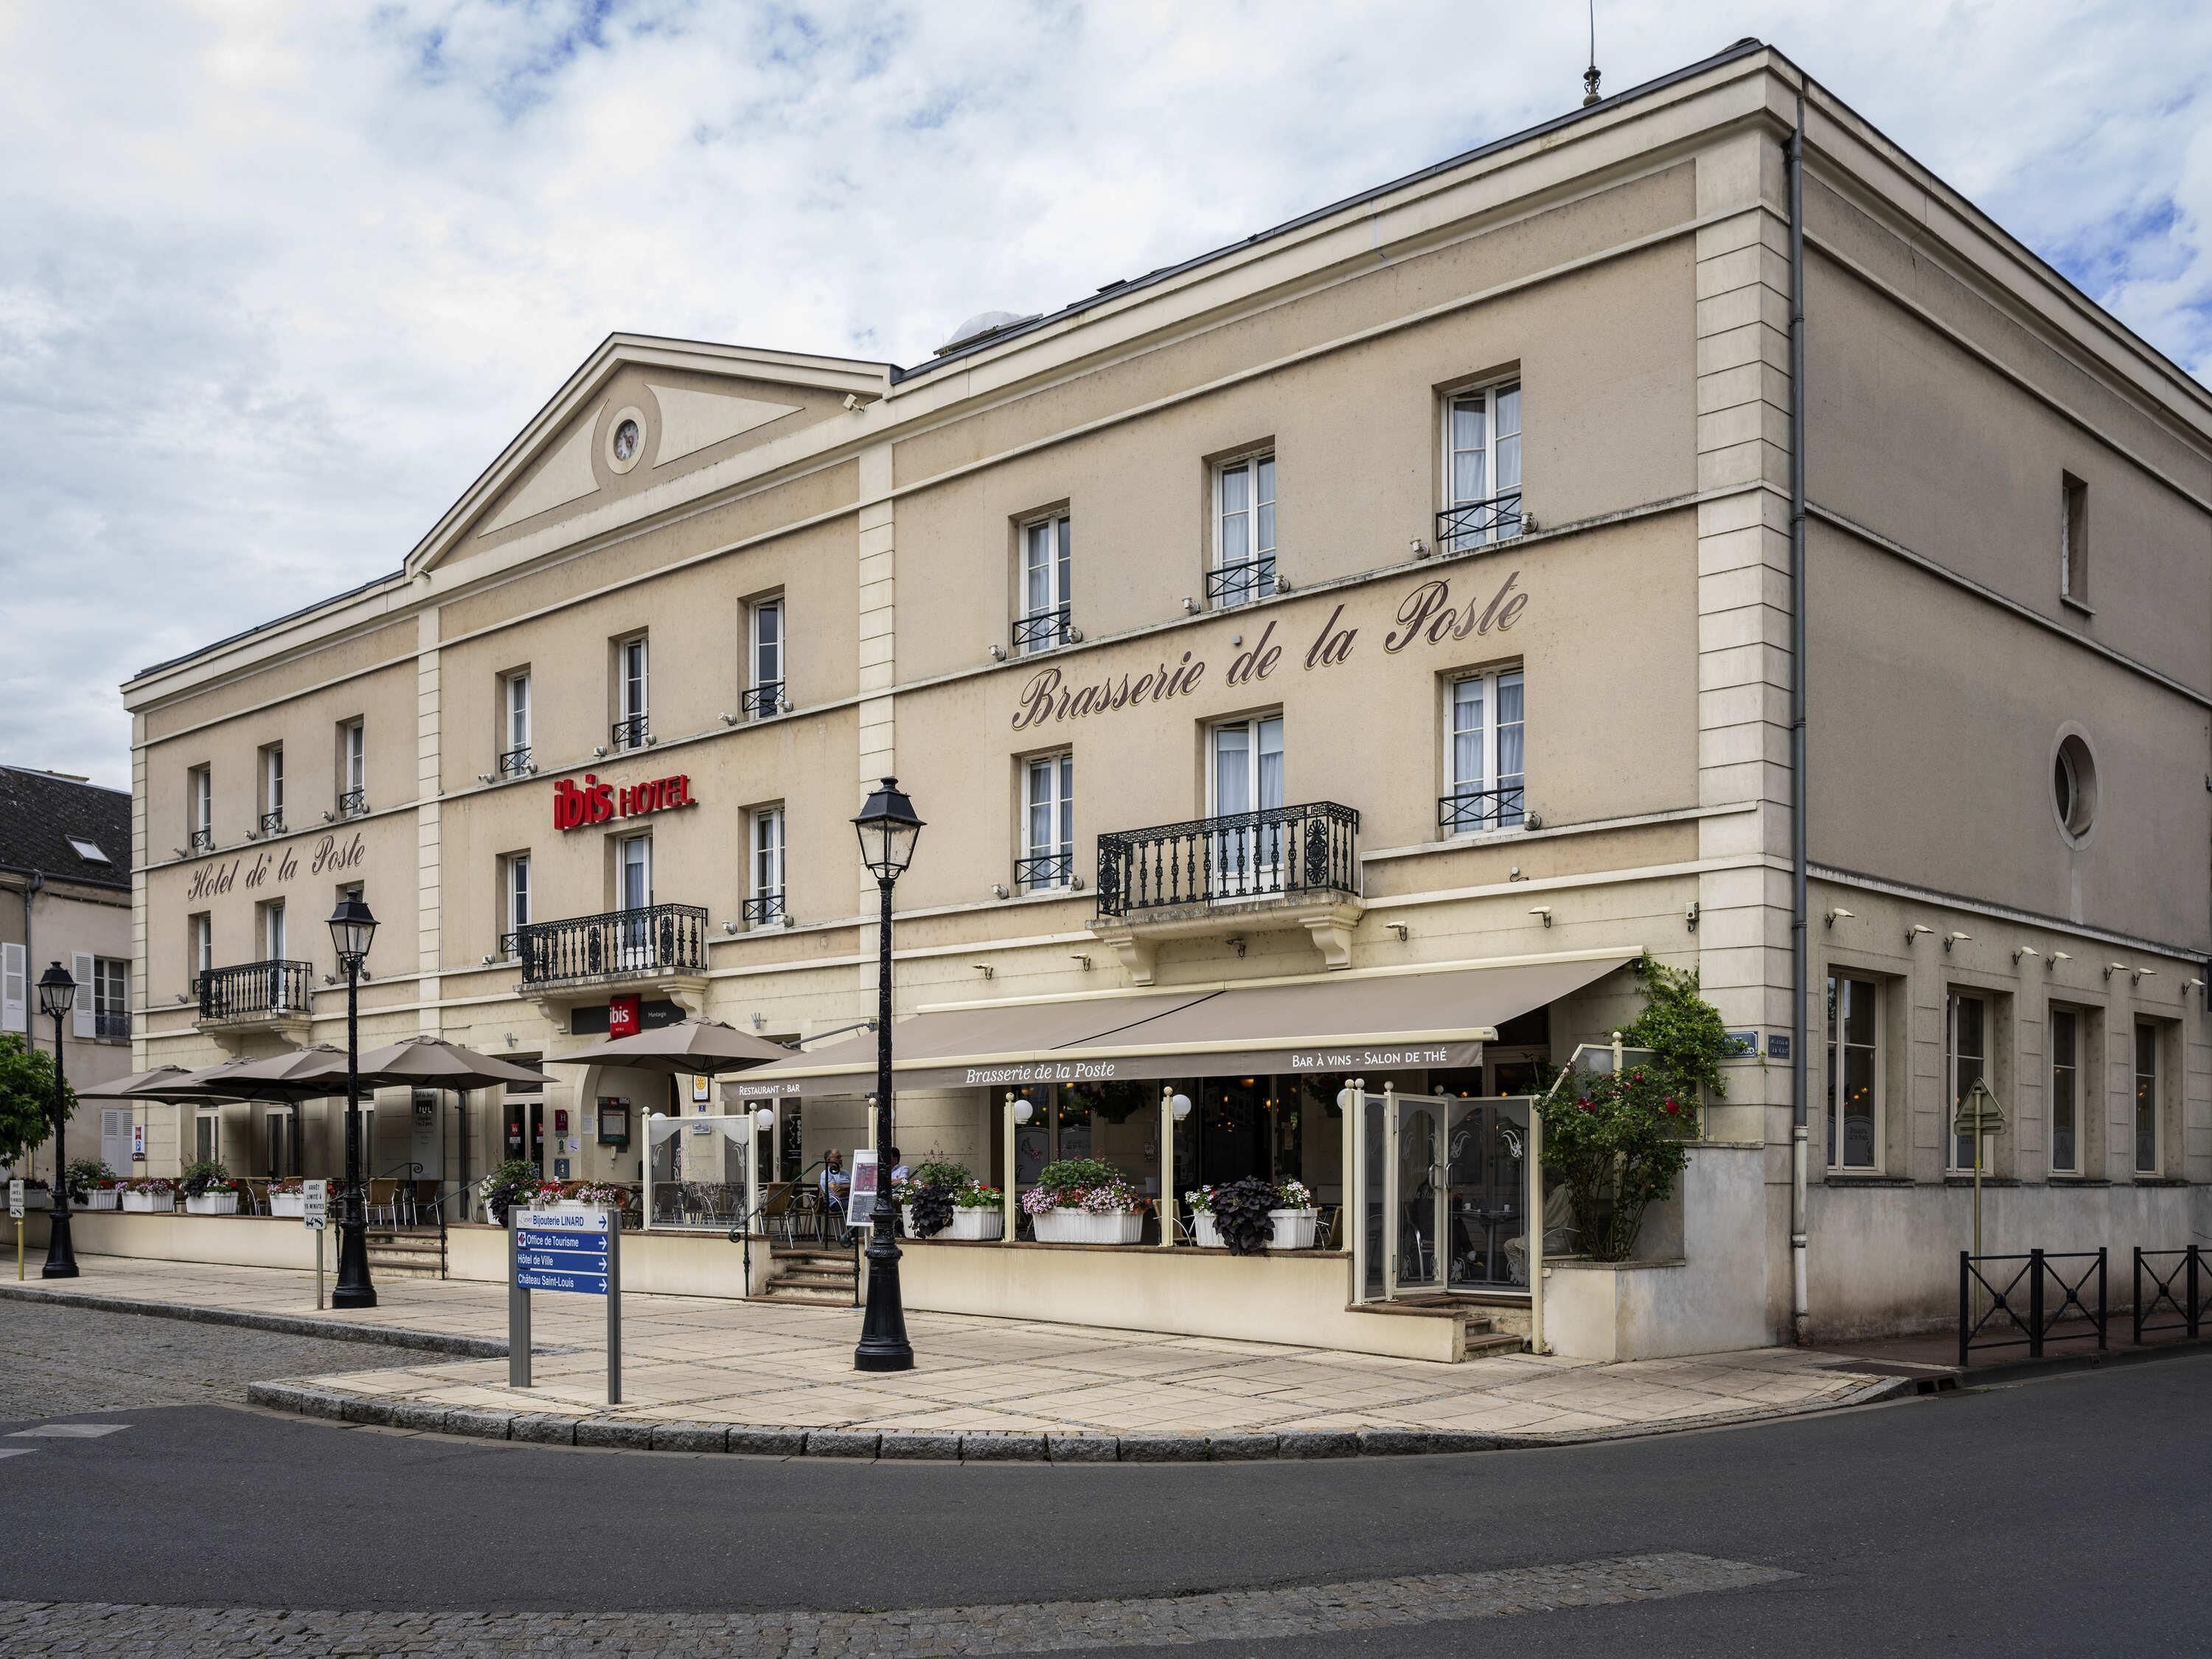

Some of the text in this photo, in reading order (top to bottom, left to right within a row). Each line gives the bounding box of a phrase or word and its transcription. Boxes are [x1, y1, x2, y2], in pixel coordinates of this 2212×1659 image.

[1011, 571, 1530, 730] Brasserie de la Poste
[554, 773, 696, 830] ibis HOTEL
[187, 832, 365, 901] Hotel de la Poste
[609, 1006, 629, 1024] ibis
[1293, 1055, 1313, 1068] BAR
[1316, 1053, 1324, 1066] À
[1326, 1055, 1351, 1066] VINS
[1364, 1051, 1401, 1065] SALON
[1405, 1051, 1420, 1062] DE
[1424, 1047, 1447, 1061] THÉ
[966, 1061, 1115, 1083] Brasserie de la Poste
[739, 1085, 780, 1096] RESTAURANT
[787, 1084, 800, 1093] BAR
[532, 1215, 560, 1227] Bijouterie
[561, 1216, 584, 1226] LINARD
[526, 1234, 579, 1247] Office de Tourisme
[518, 1253, 553, 1265] Hôtel de Ville
[518, 1274, 574, 1287] Château Saint-Louis
